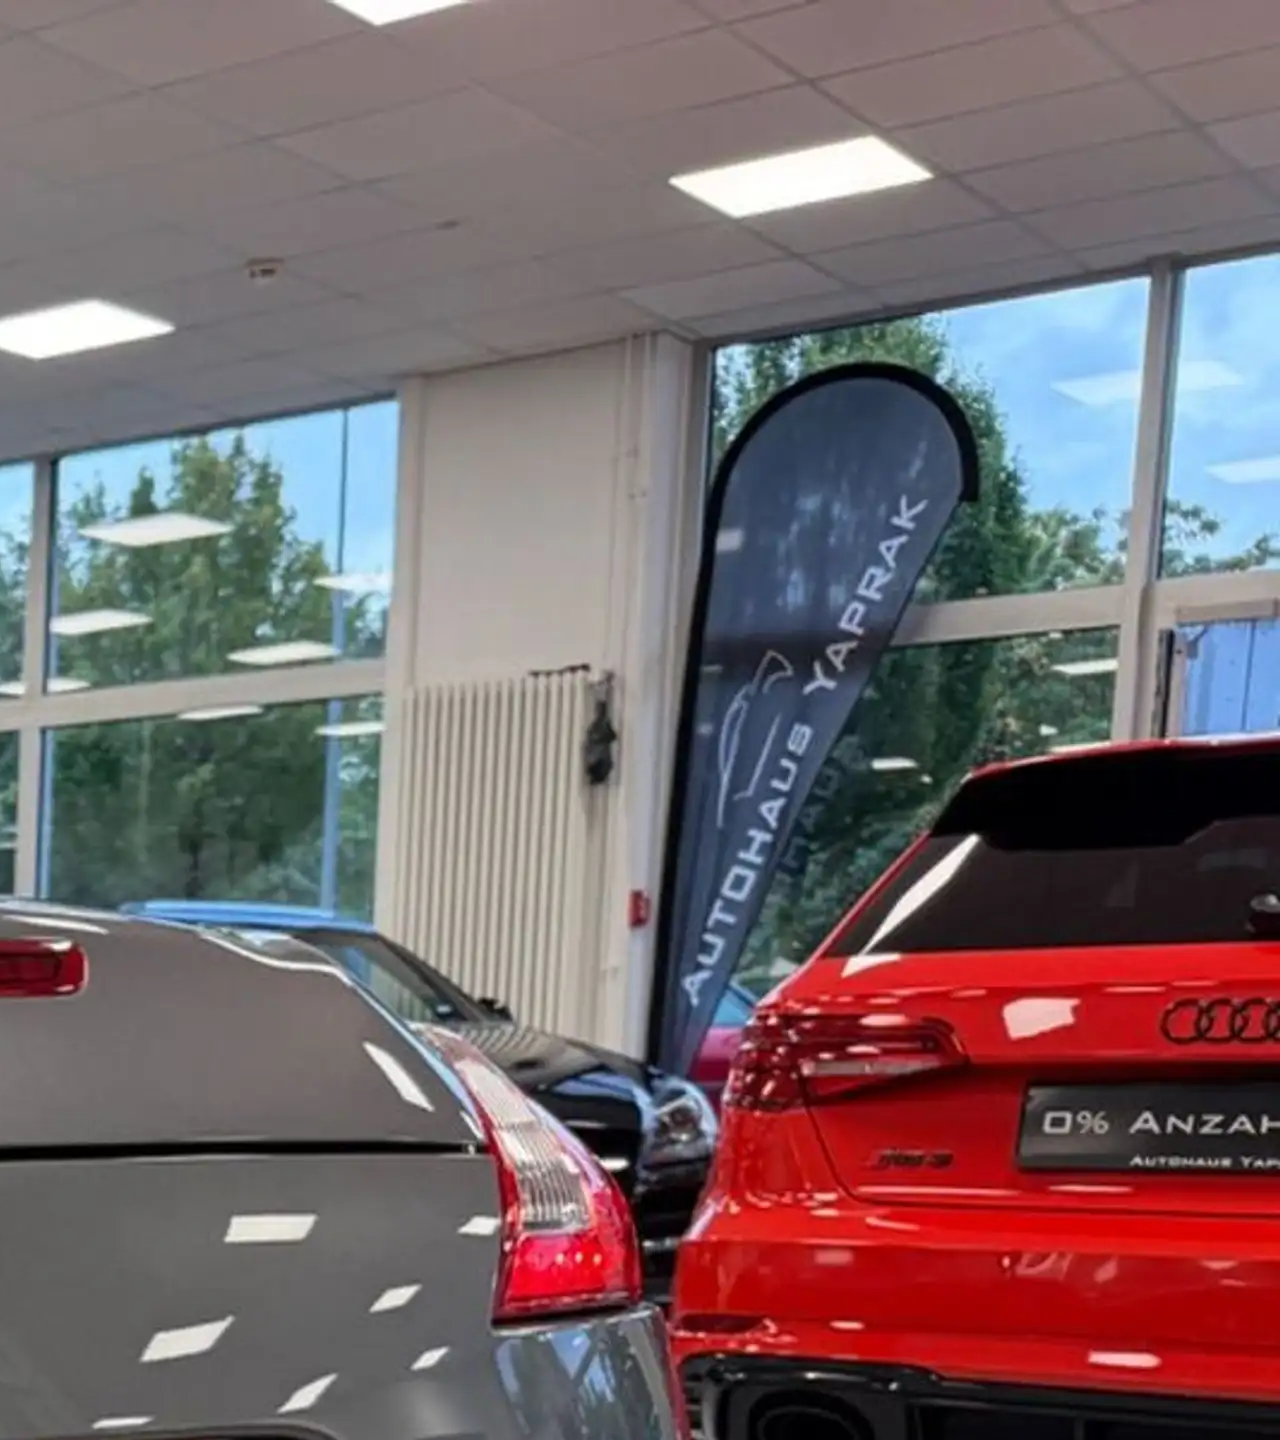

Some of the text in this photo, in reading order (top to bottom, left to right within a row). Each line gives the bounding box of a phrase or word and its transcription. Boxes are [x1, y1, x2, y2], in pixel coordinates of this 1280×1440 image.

[680, 721, 815, 1008] AUTOHAUS
[802, 494, 929, 697] YAPRAK
[1042, 1110, 1110, 1135] 0%
